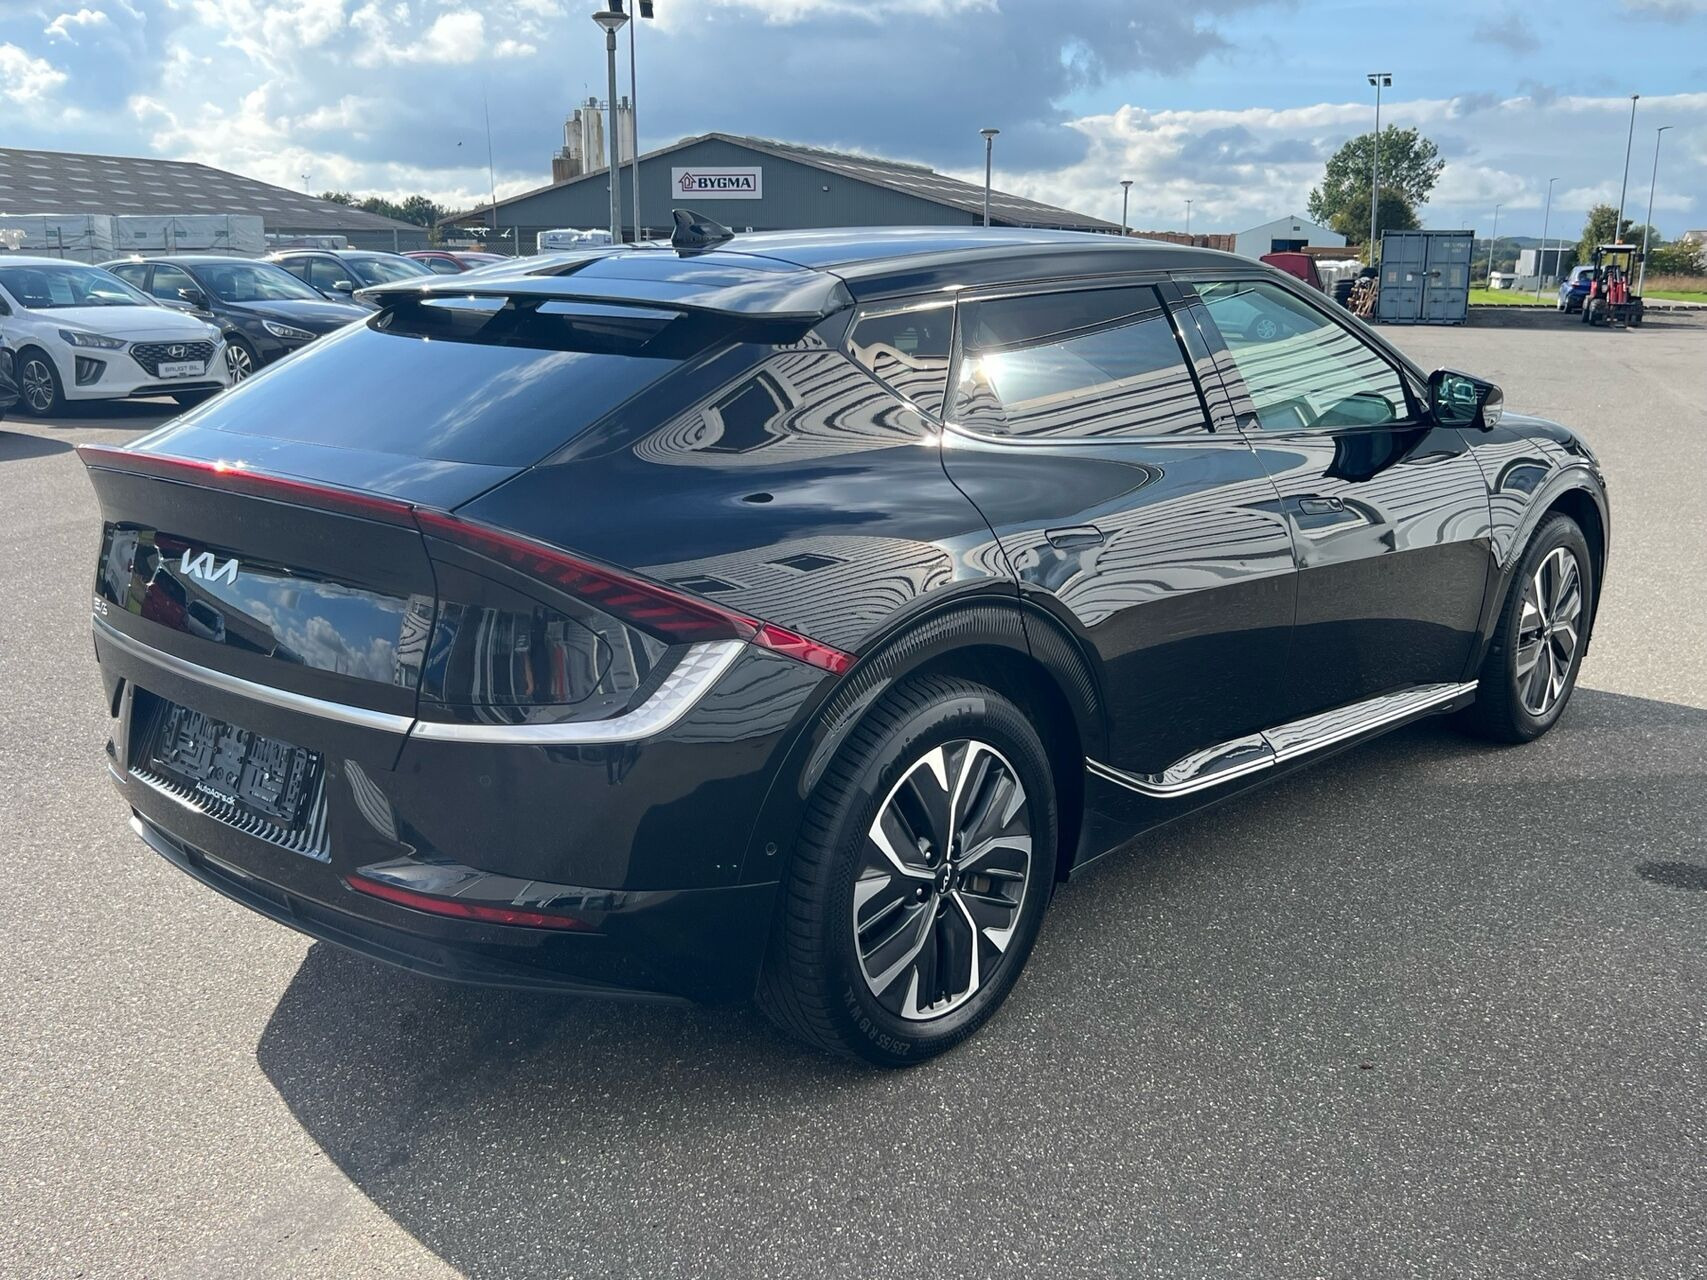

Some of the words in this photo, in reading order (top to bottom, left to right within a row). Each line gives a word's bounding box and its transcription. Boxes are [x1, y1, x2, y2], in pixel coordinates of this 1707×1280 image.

[698, 177, 751, 188] BYGMA
[180, 547, 239, 586] KIA
[858, 1017, 871, 1033] 19
[868, 1026, 879, 1040] R
[875, 1033, 911, 1056] 235/55
